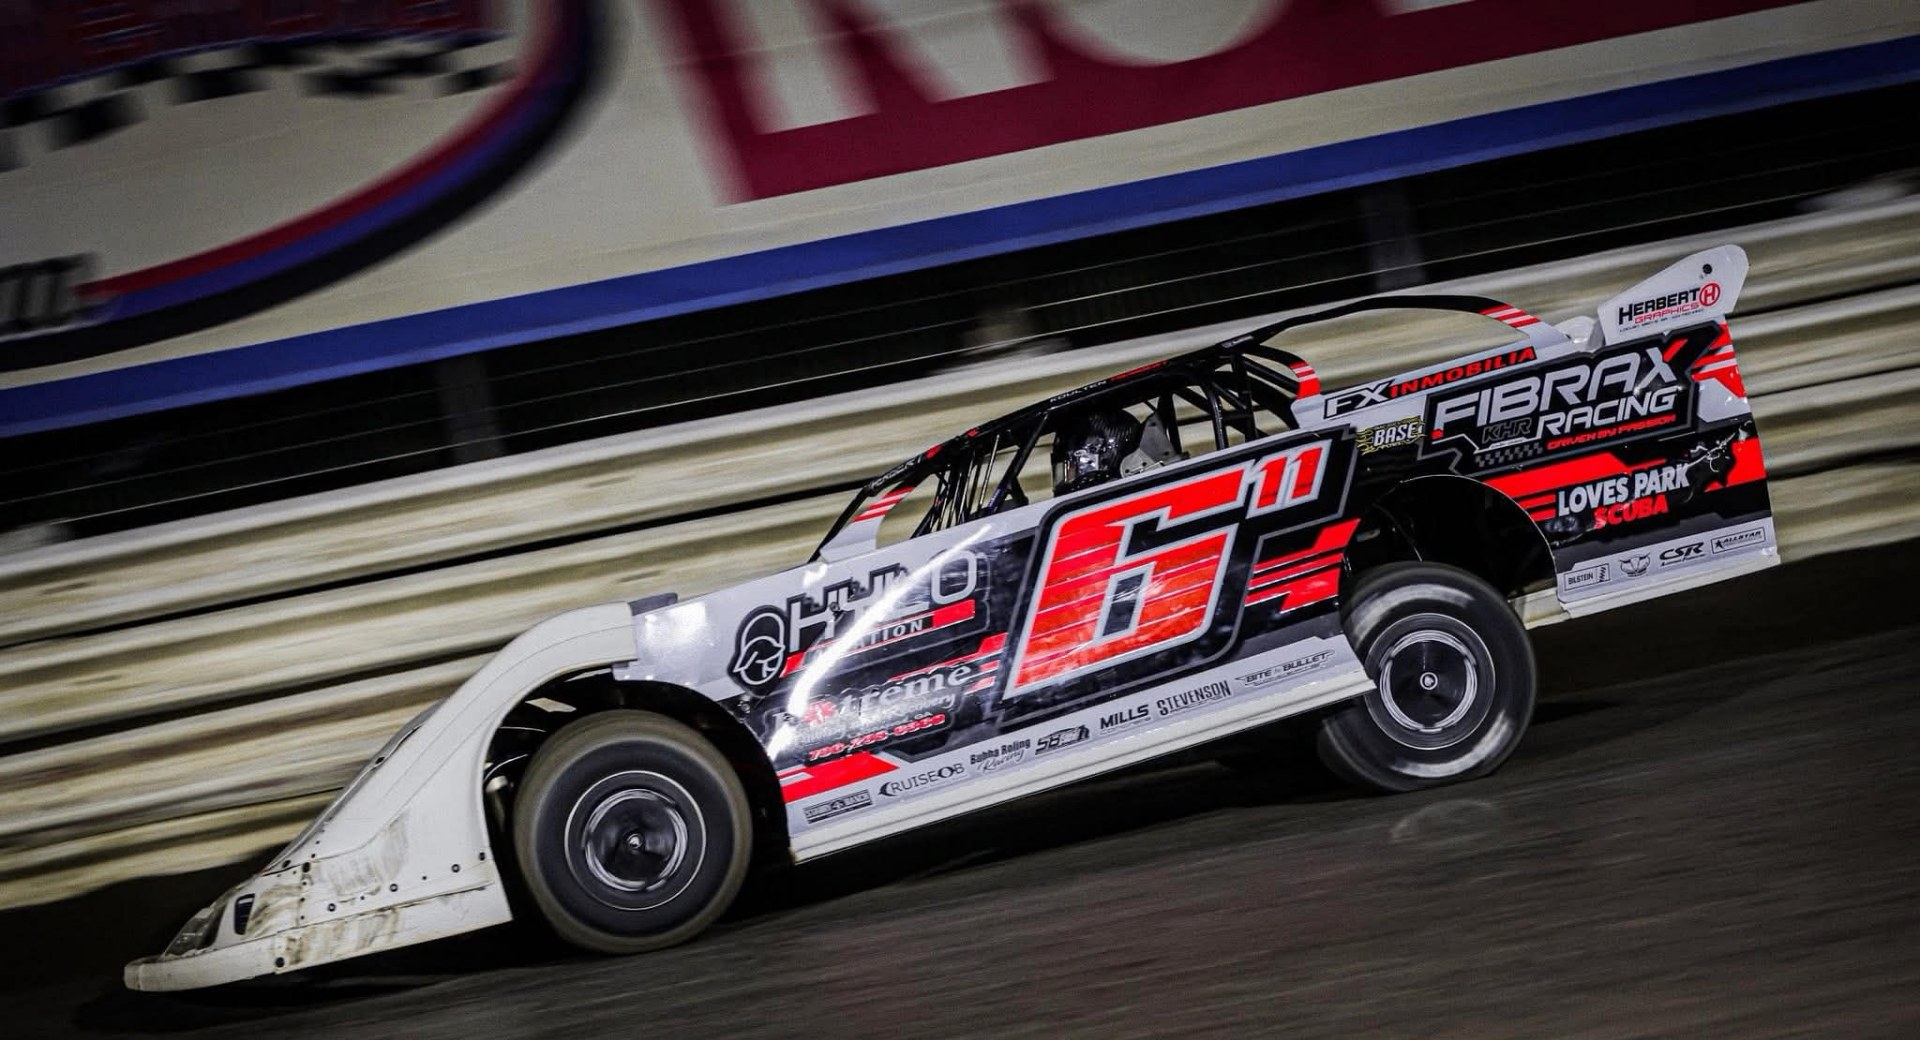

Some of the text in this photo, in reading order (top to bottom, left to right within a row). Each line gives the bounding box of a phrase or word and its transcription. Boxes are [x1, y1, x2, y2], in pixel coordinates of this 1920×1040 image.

[1618, 287, 1701, 325] HERBERT
[1634, 302, 1700, 324] GRAPHICS
[1325, 346, 1535, 419] FX INMOBILIA
[1432, 339, 1688, 440] FIBRAX
[1481, 417, 1532, 444] KHR
[1536, 386, 1680, 439] RACING
[1546, 432, 1596, 450] DRIVEN
[1596, 427, 1617, 440] BY
[1618, 414, 1676, 436] PASSION
[1558, 463, 1690, 517] LOVES PARK
[1594, 494, 1669, 530] SCUBA
[1004, 442, 1328, 698] 6 11
[1659, 542, 1705, 562] CSR
[1567, 571, 1594, 585] BILSTEIN
[1246, 669, 1273, 685] BITE
[1282, 652, 1328, 672] BULLET
[1156, 680, 1232, 716] STEVENSON
[1100, 704, 1149, 730] MILLS
[970, 748, 1000, 765] Bubba
[977, 750, 1026, 774] Racing
